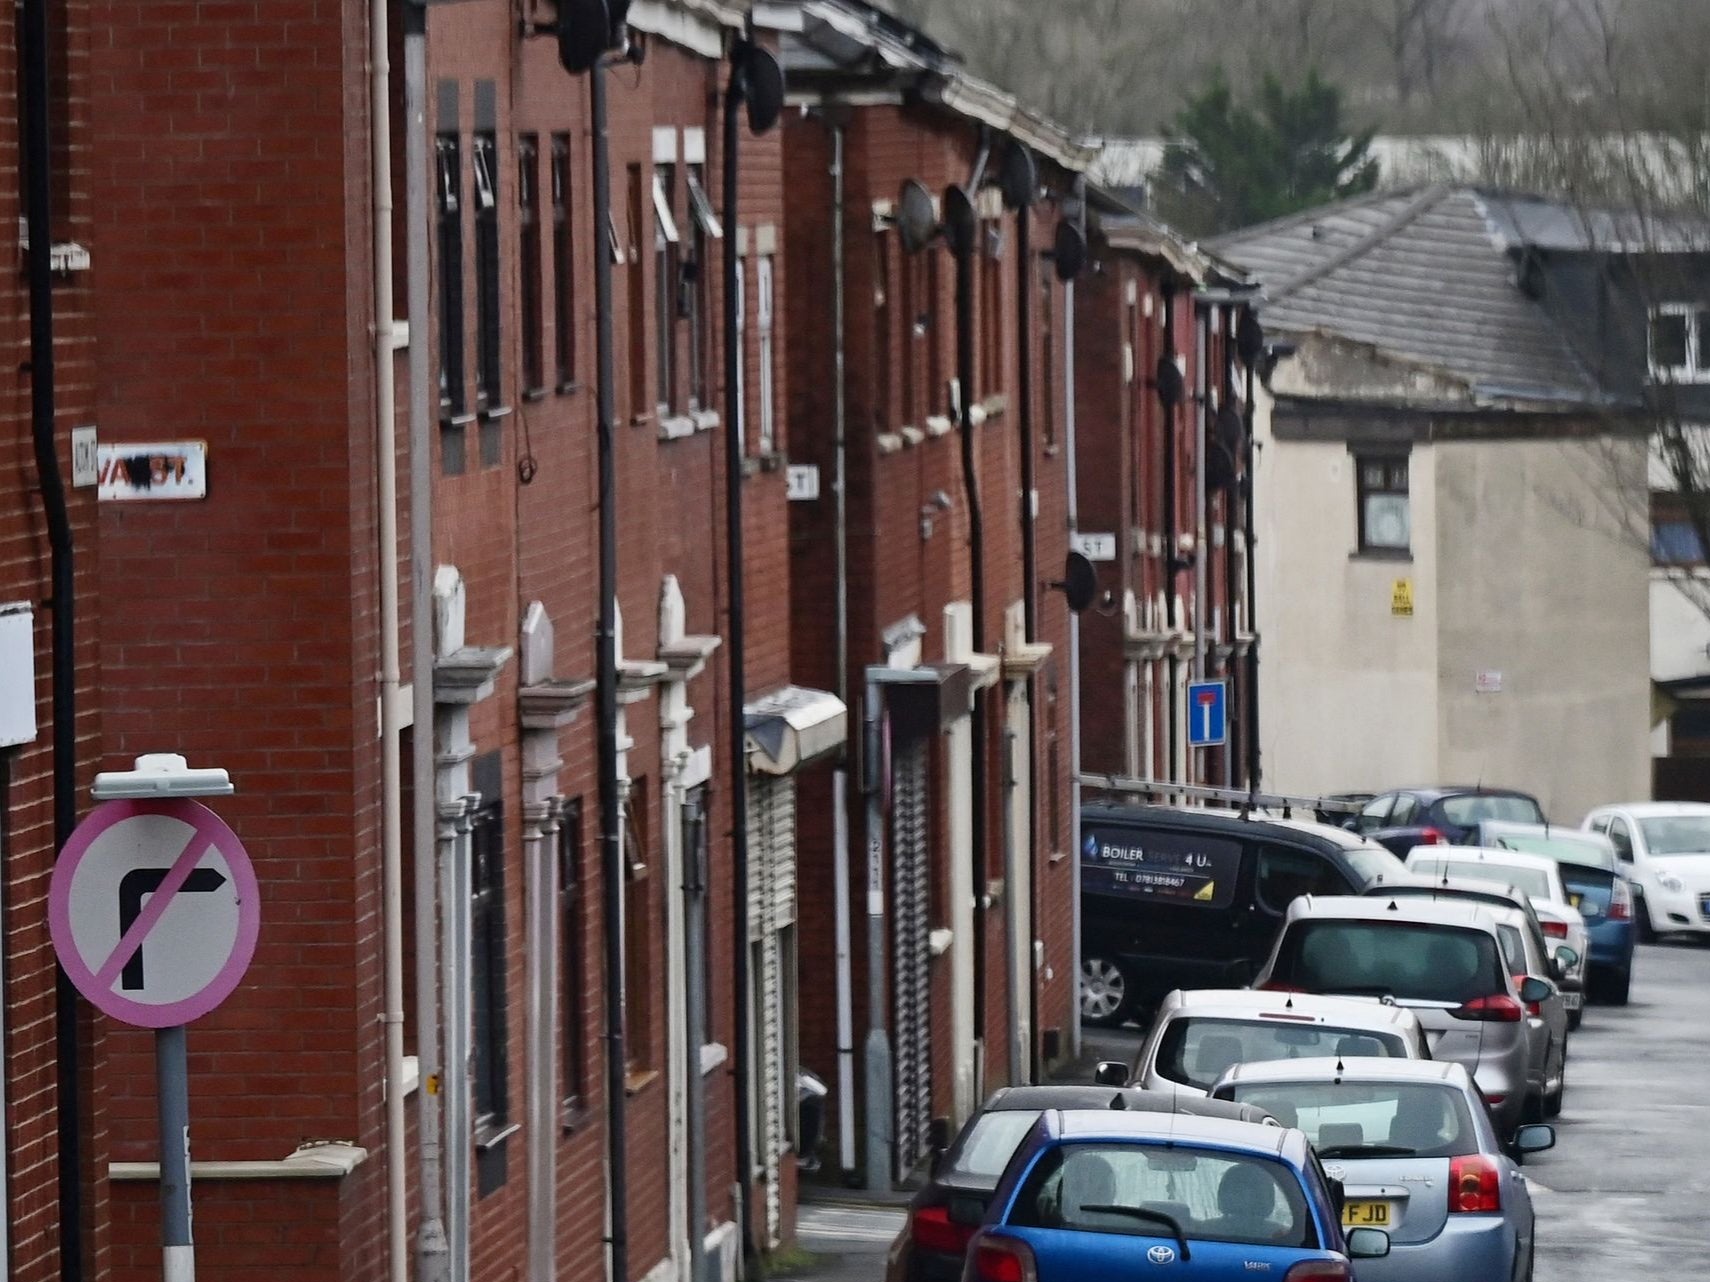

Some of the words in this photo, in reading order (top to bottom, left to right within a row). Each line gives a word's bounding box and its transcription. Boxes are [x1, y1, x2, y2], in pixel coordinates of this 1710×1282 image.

[1102, 845, 1144, 862] BOILER
[1185, 852, 1193, 866] 4
[1196, 854, 1207, 868] U
[1115, 872, 1129, 882] TEL
